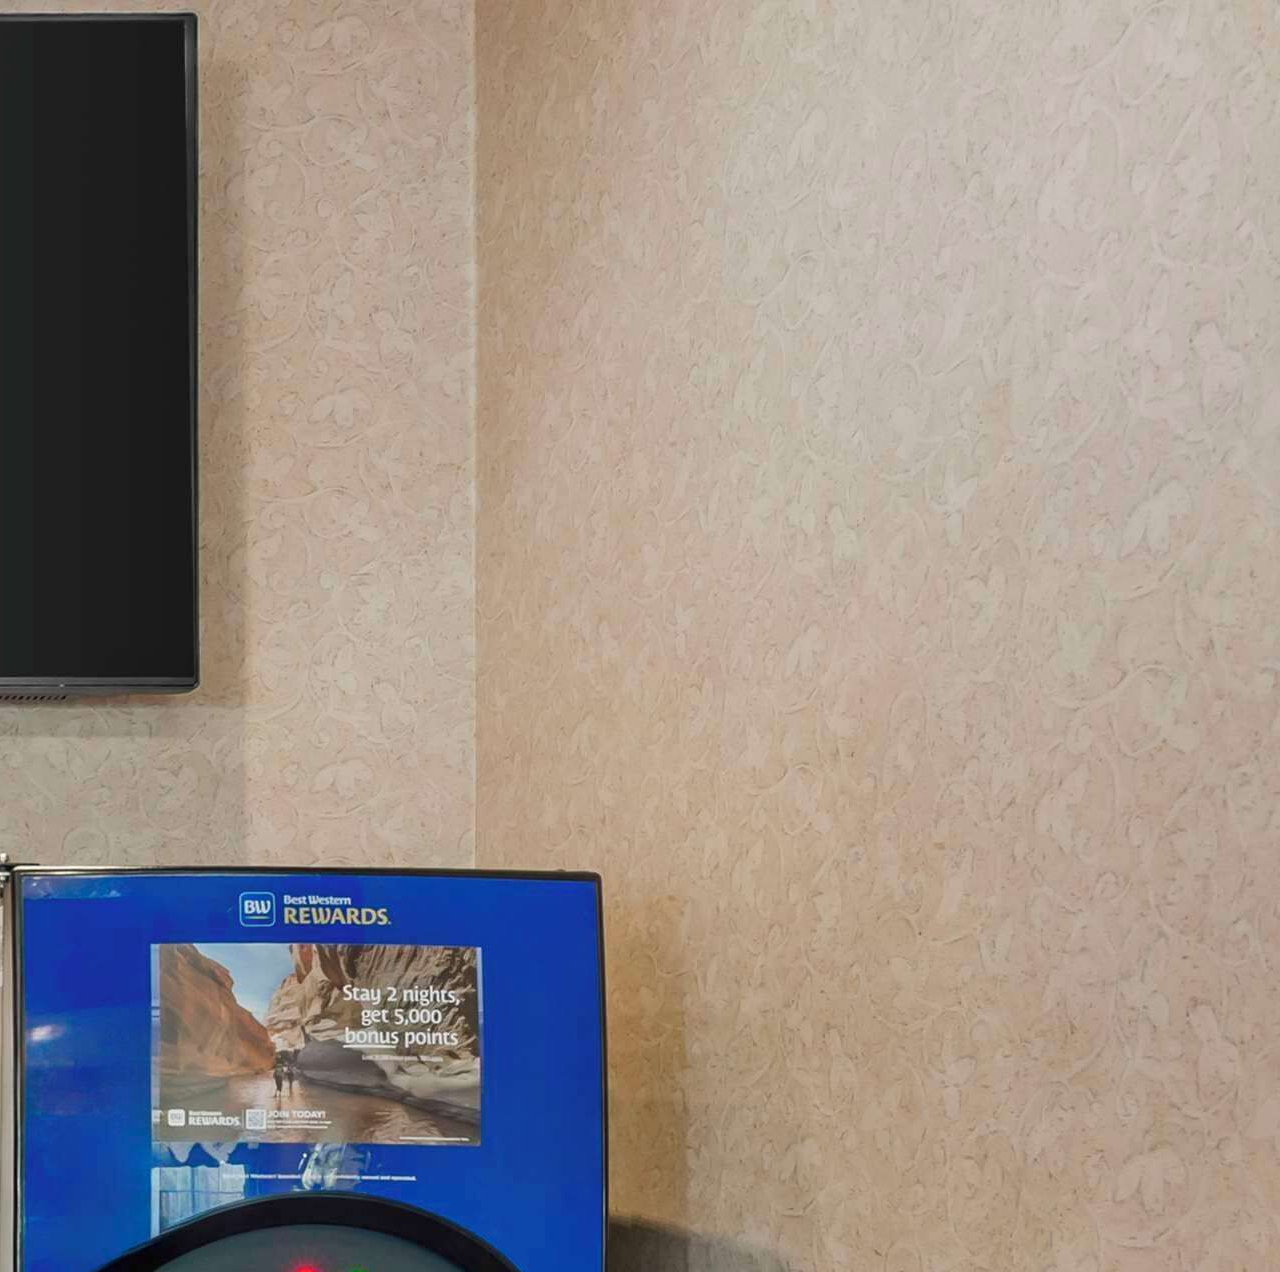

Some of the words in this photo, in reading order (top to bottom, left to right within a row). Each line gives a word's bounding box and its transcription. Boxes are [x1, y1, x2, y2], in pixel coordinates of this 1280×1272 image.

[244, 900, 271, 914] BW
[283, 895, 306, 905] Best
[308, 895, 351, 905] Western
[343, 984, 381, 1005] Stay
[387, 987, 397, 1001] 2
[403, 985, 460, 1006] nights,
[361, 1009, 389, 1026] get
[394, 1009, 442, 1025] 5,000
[344, 1027, 399, 1044] bonus
[405, 1028, 459, 1048] points
[292, 1110, 326, 1119] TODAY!
